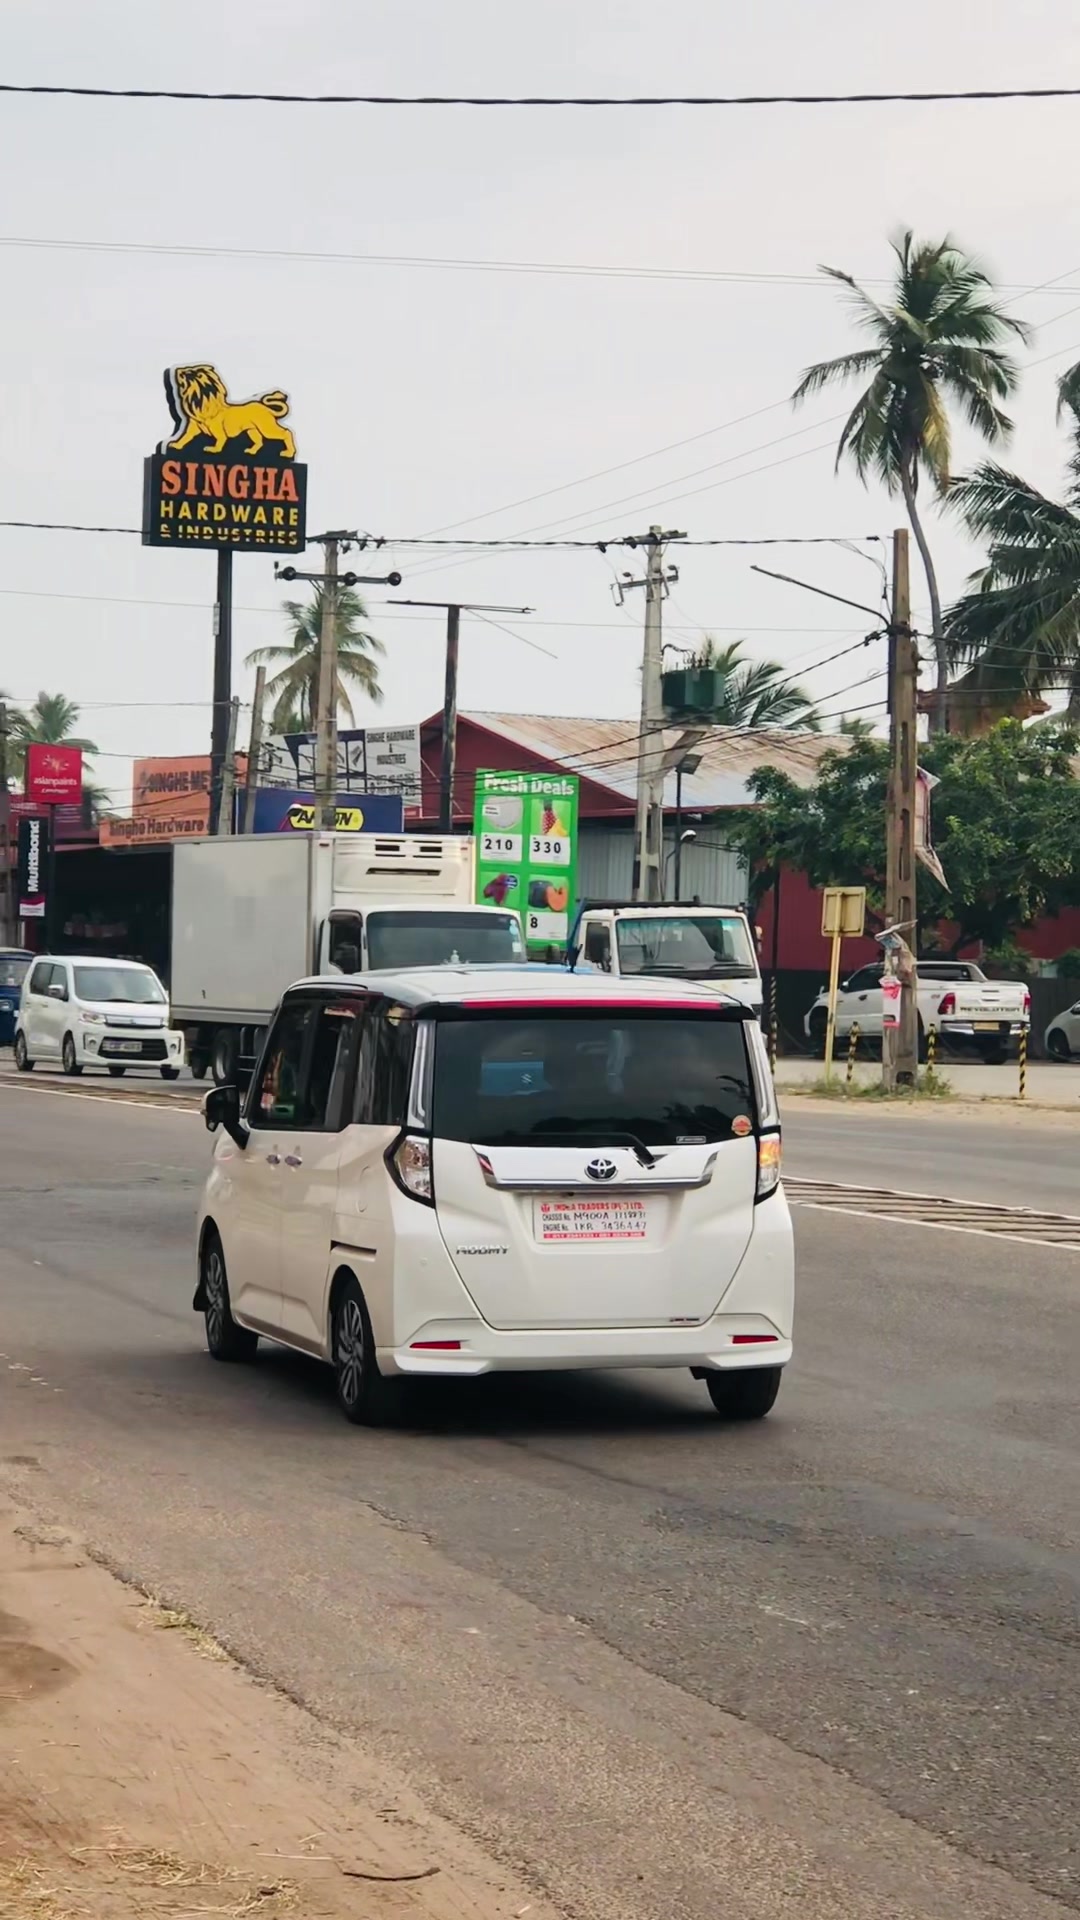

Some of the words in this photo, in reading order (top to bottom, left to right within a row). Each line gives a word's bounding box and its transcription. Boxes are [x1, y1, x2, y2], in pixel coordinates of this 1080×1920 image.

[161, 460, 299, 502] SINGHA
[160, 500, 298, 526] HARDWARE
[160, 524, 171, 538] &
[178, 525, 298, 545] INDUSTRIES
[34, 776, 77, 788] asianpaints
[484, 773, 528, 793] Fresh
[531, 777, 574, 796] Deals
[484, 838, 513, 851] 210
[532, 840, 562, 854] 330
[27, 820, 40, 893] Multibond
